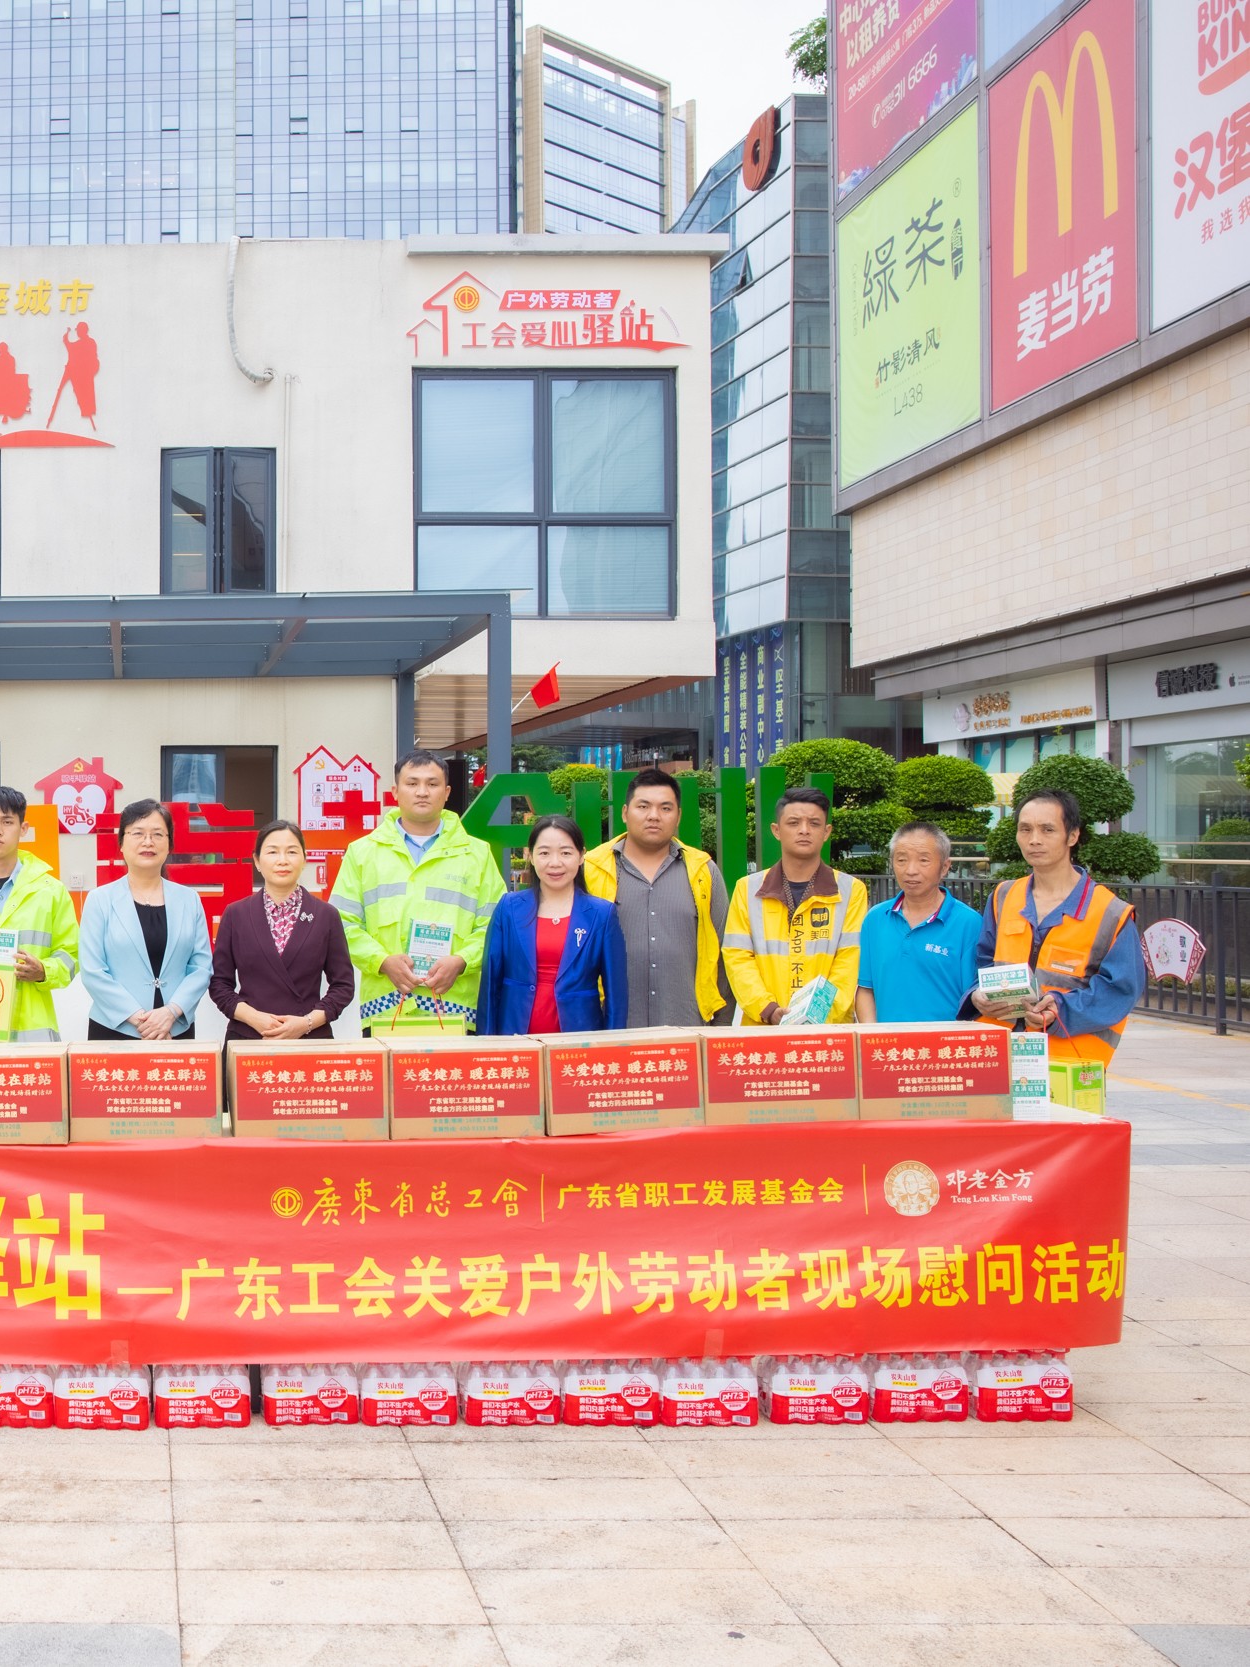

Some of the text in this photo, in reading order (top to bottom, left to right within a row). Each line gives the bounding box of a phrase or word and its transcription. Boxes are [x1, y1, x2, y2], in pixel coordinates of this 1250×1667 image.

[907, 43, 938, 90] 6666
[506, 292, 614, 309] 户外劳动者
[1017, 245, 1115, 362] 麦当劳
[461, 306, 655, 348] 工会爱心驿站
[877, 327, 940, 384] 竹影清风
[894, 384, 924, 416] L438
[924, 943, 949, 957] 新基业
[1012, 1043, 1040, 1051] 老清冠饮
[717, 1048, 844, 1066] 关爱健康 暖在驿站
[246, 1068, 373, 1083] 关爱健康 暖在驿站
[402, 1065, 529, 1082] 关爱健康 暖在驿站
[560, 1058, 688, 1077] 关爱健康 暖在驿站
[945, 1168, 1035, 1195] 邓老金方
[558, 1177, 846, 1210] 广东省职工发展基金会
[950, 1193, 1033, 1204] Teng Lou Kim Fong
